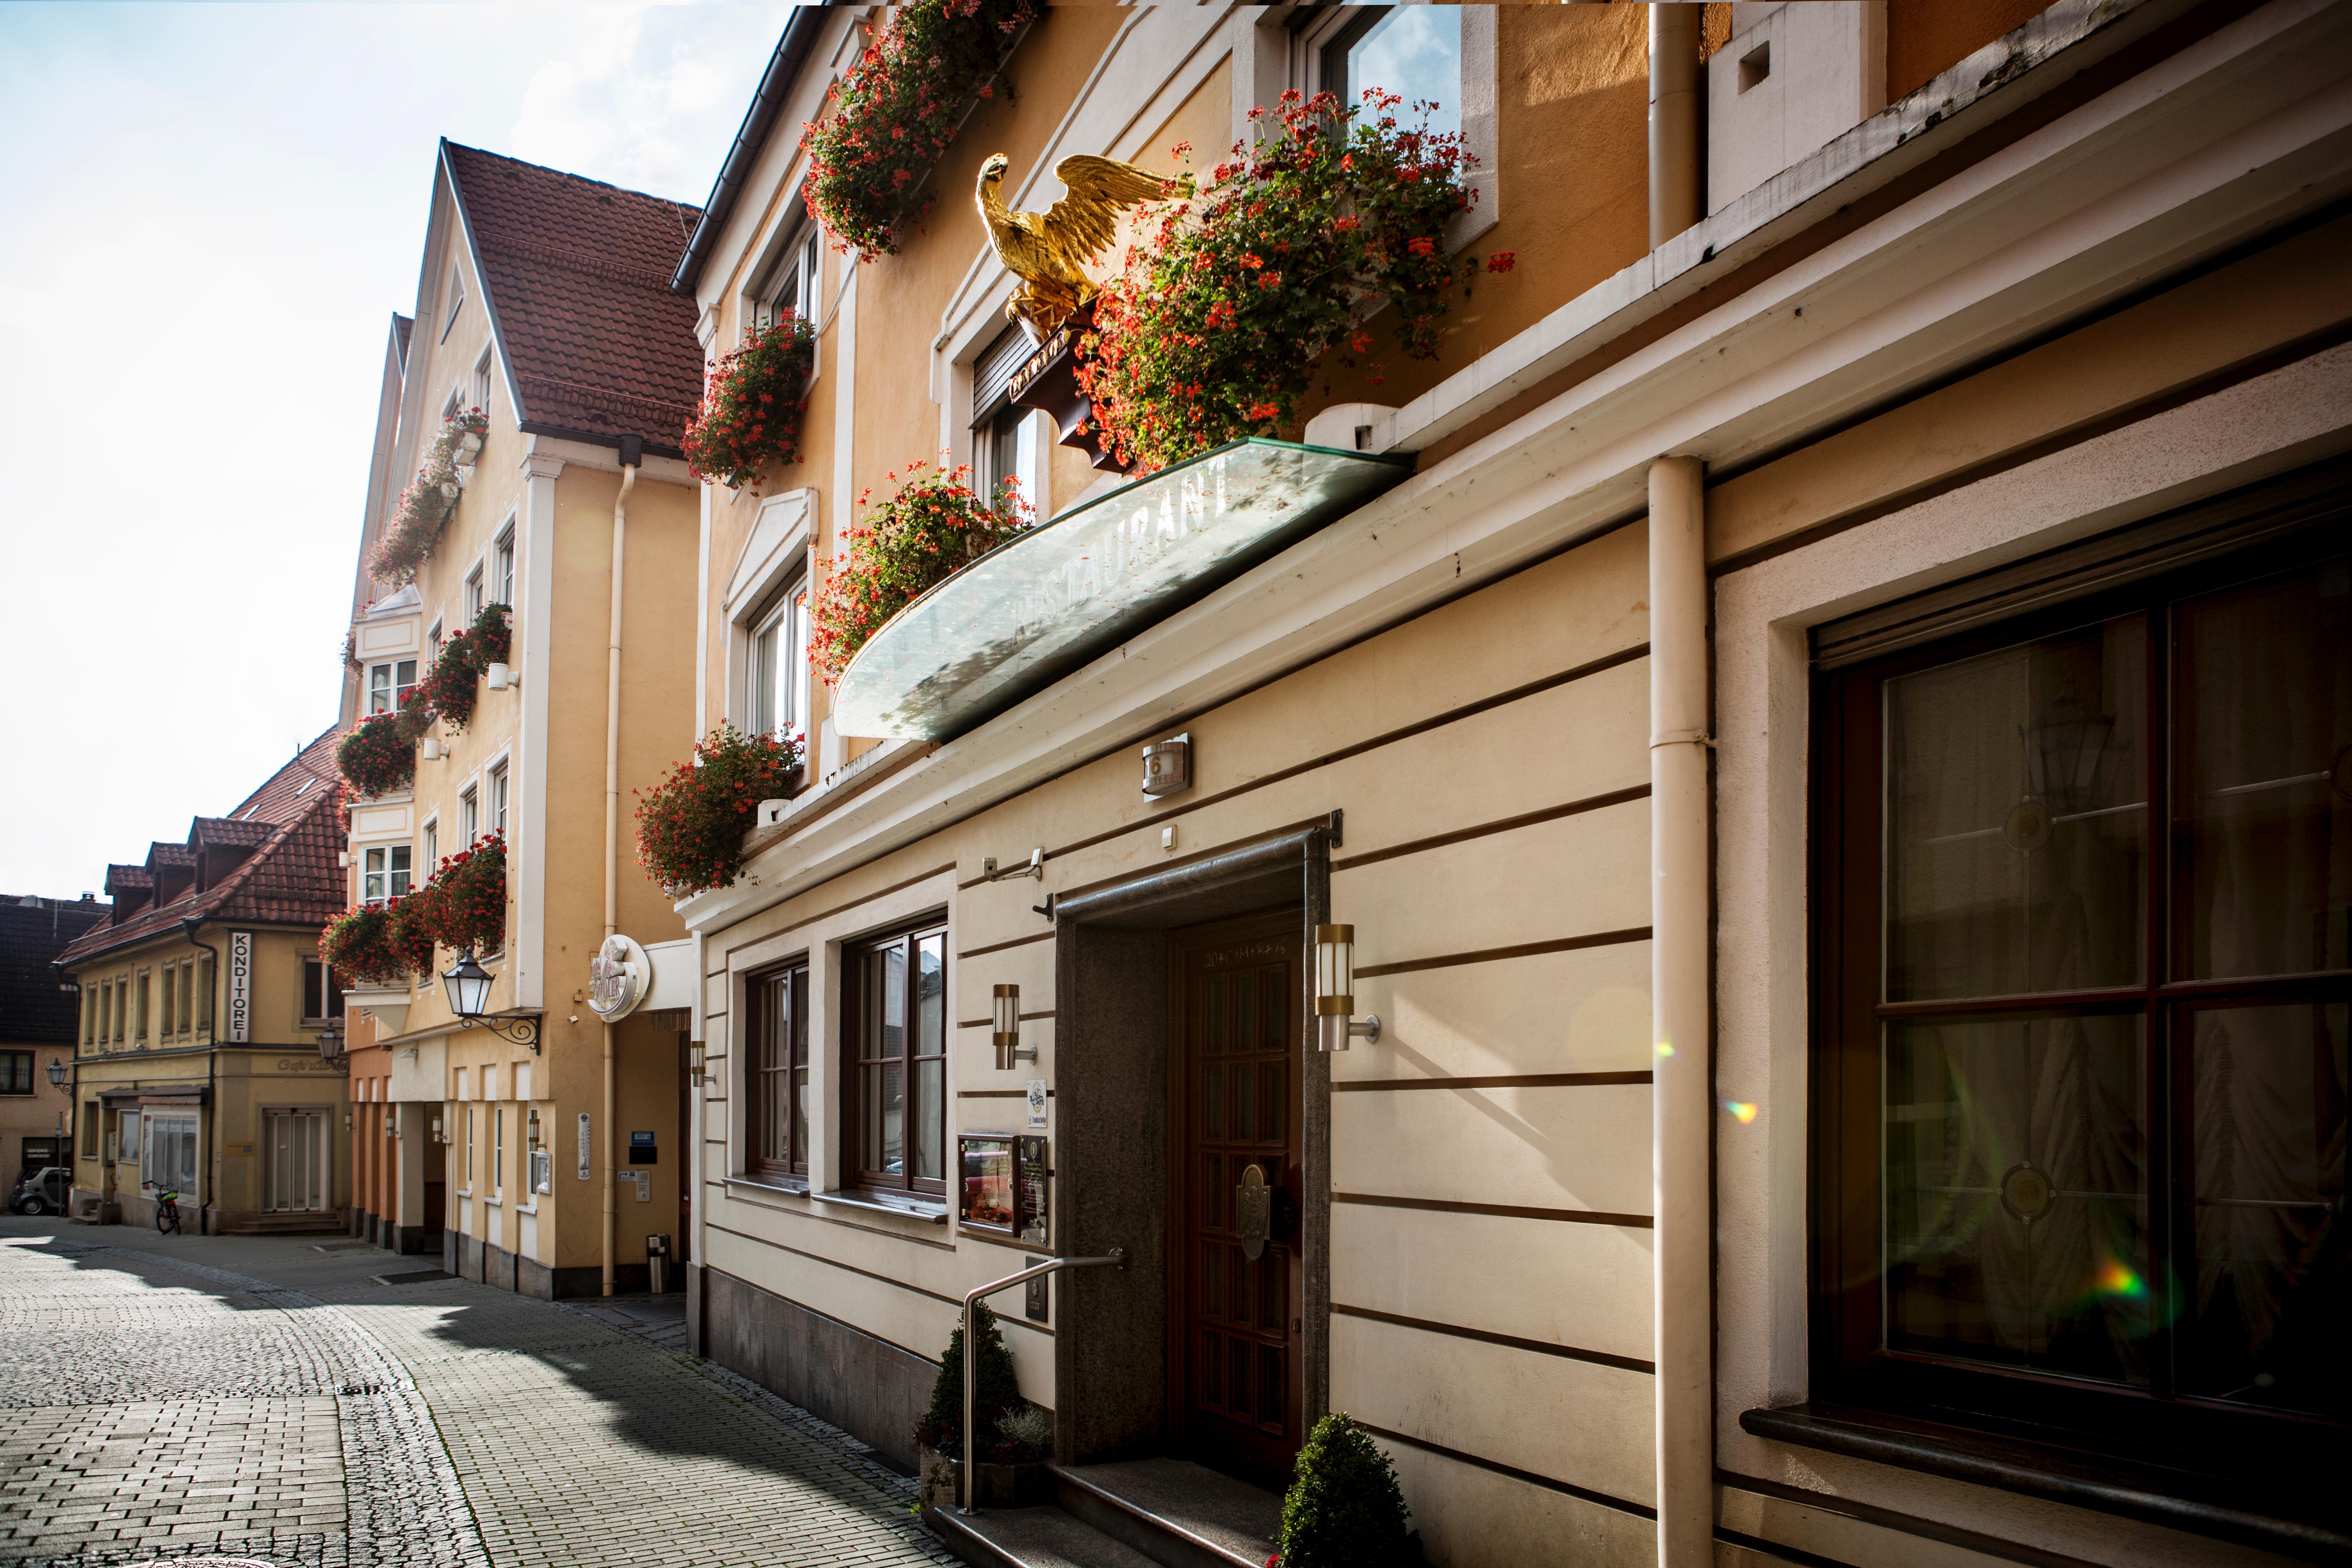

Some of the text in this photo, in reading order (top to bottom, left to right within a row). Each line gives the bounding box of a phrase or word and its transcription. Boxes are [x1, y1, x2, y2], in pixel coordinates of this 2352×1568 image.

[1011, 453, 1235, 648] RESTAURANT
[1146, 756, 1161, 777] 16
[233, 935, 247, 1040] KONDITOREI
[1030, 1301, 1040, 1310] CLUB
